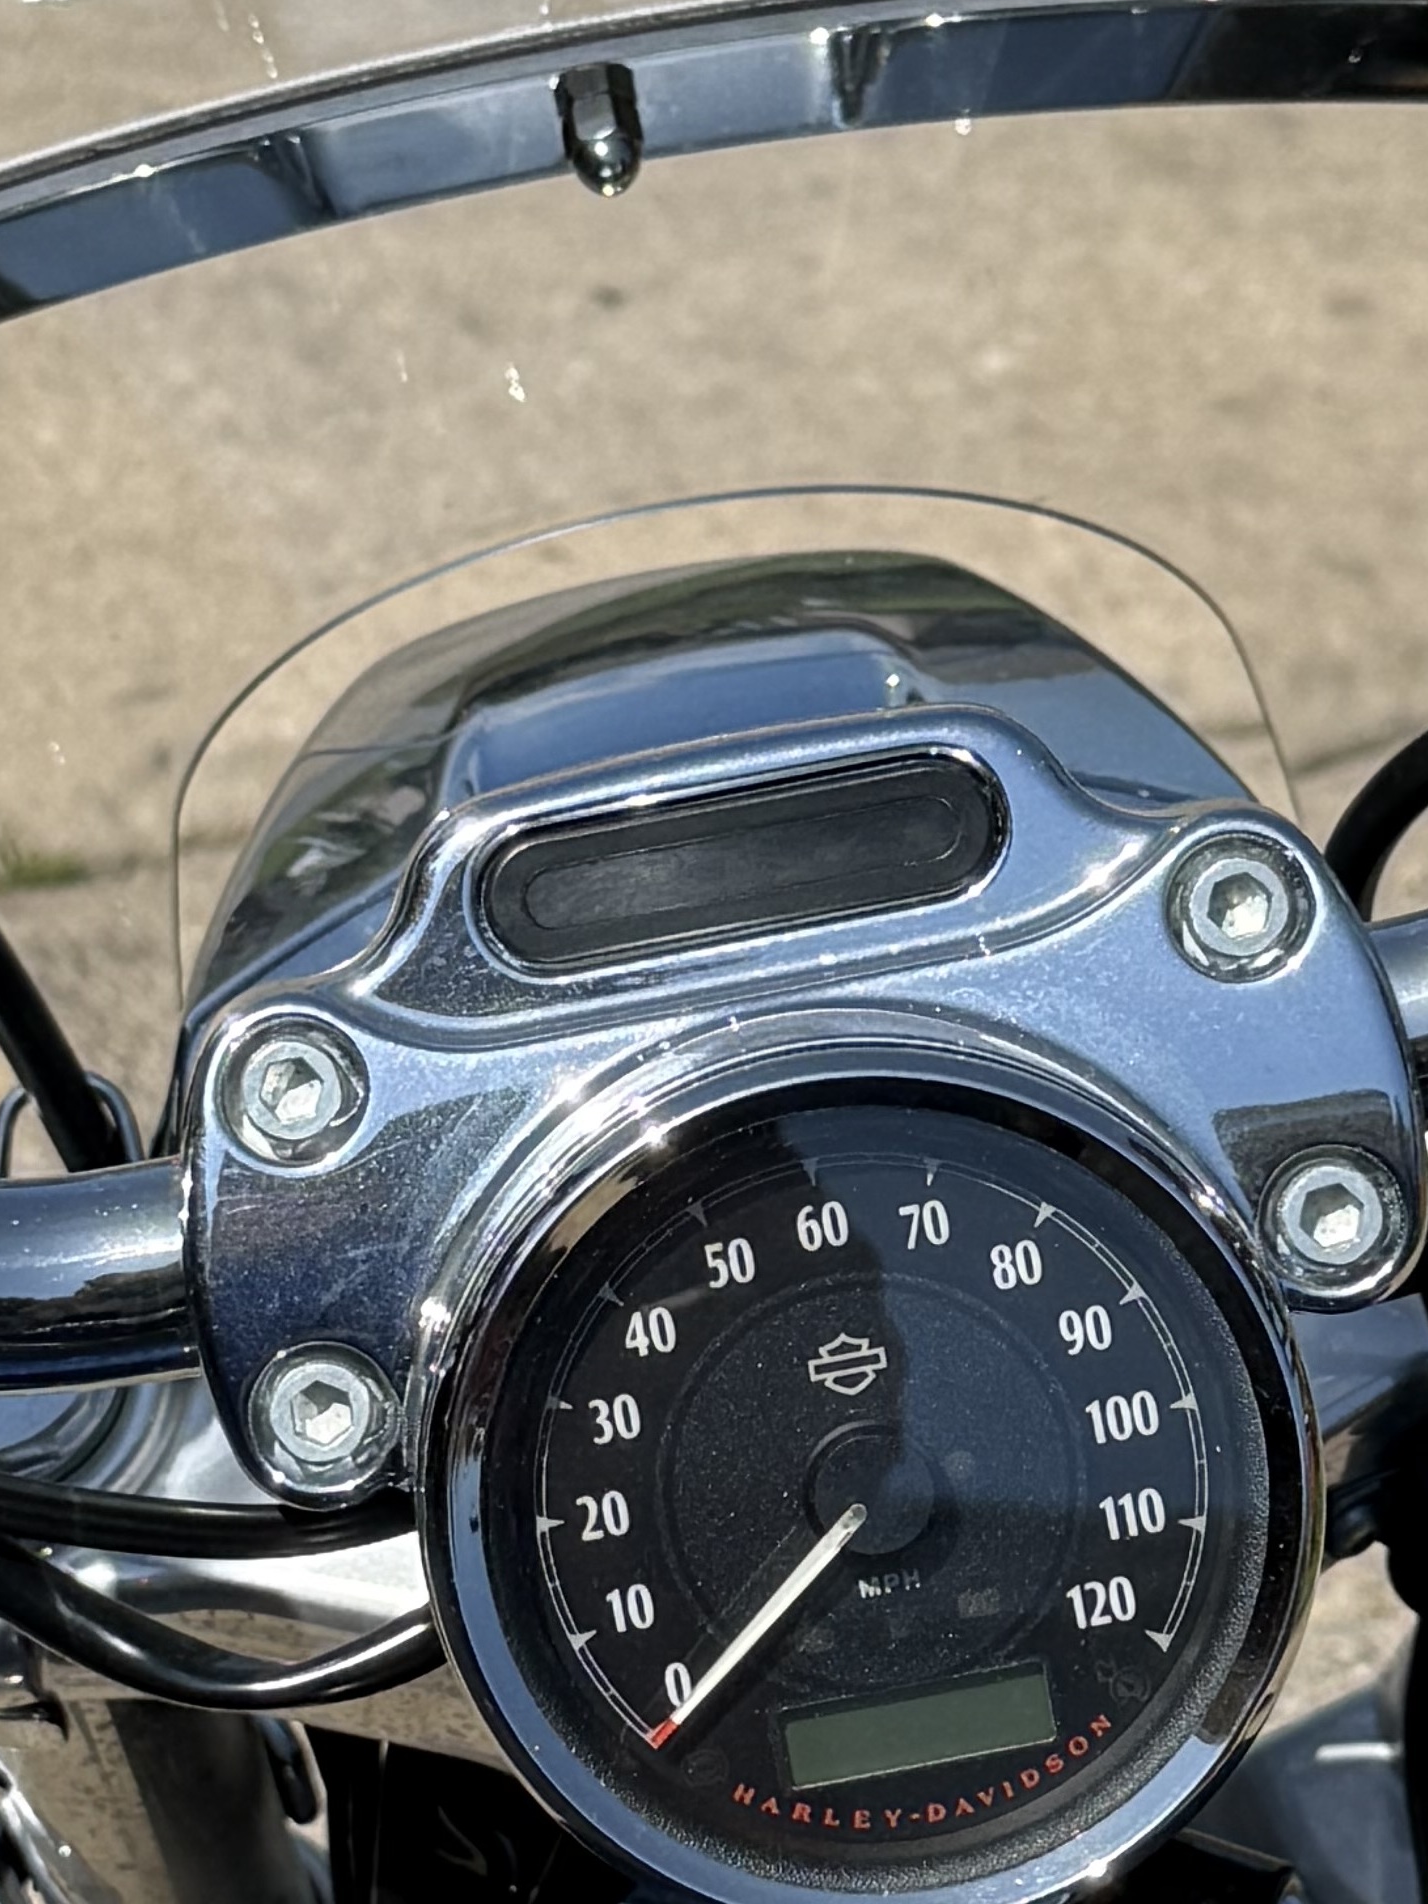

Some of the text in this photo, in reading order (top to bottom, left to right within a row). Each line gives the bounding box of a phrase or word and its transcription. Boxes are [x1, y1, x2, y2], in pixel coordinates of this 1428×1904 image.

[796, 1200, 849, 1252] 60
[898, 1199, 950, 1250] 70
[704, 1237, 755, 1289] 50
[989, 1239, 1043, 1290] 80
[625, 1306, 676, 1357] 40
[1058, 1304, 1112, 1356] 90
[588, 1393, 641, 1445] 30
[1085, 1390, 1160, 1444] 100
[575, 1490, 630, 1542] 20
[1098, 1487, 1166, 1541] 110
[605, 1583, 655, 1633] 10
[858, 1568, 921, 1599] MPH
[1066, 1576, 1136, 1630] 120
[664, 1662, 692, 1708] 0
[732, 1714, 1111, 1830] HARLEY-DAVIDSON
